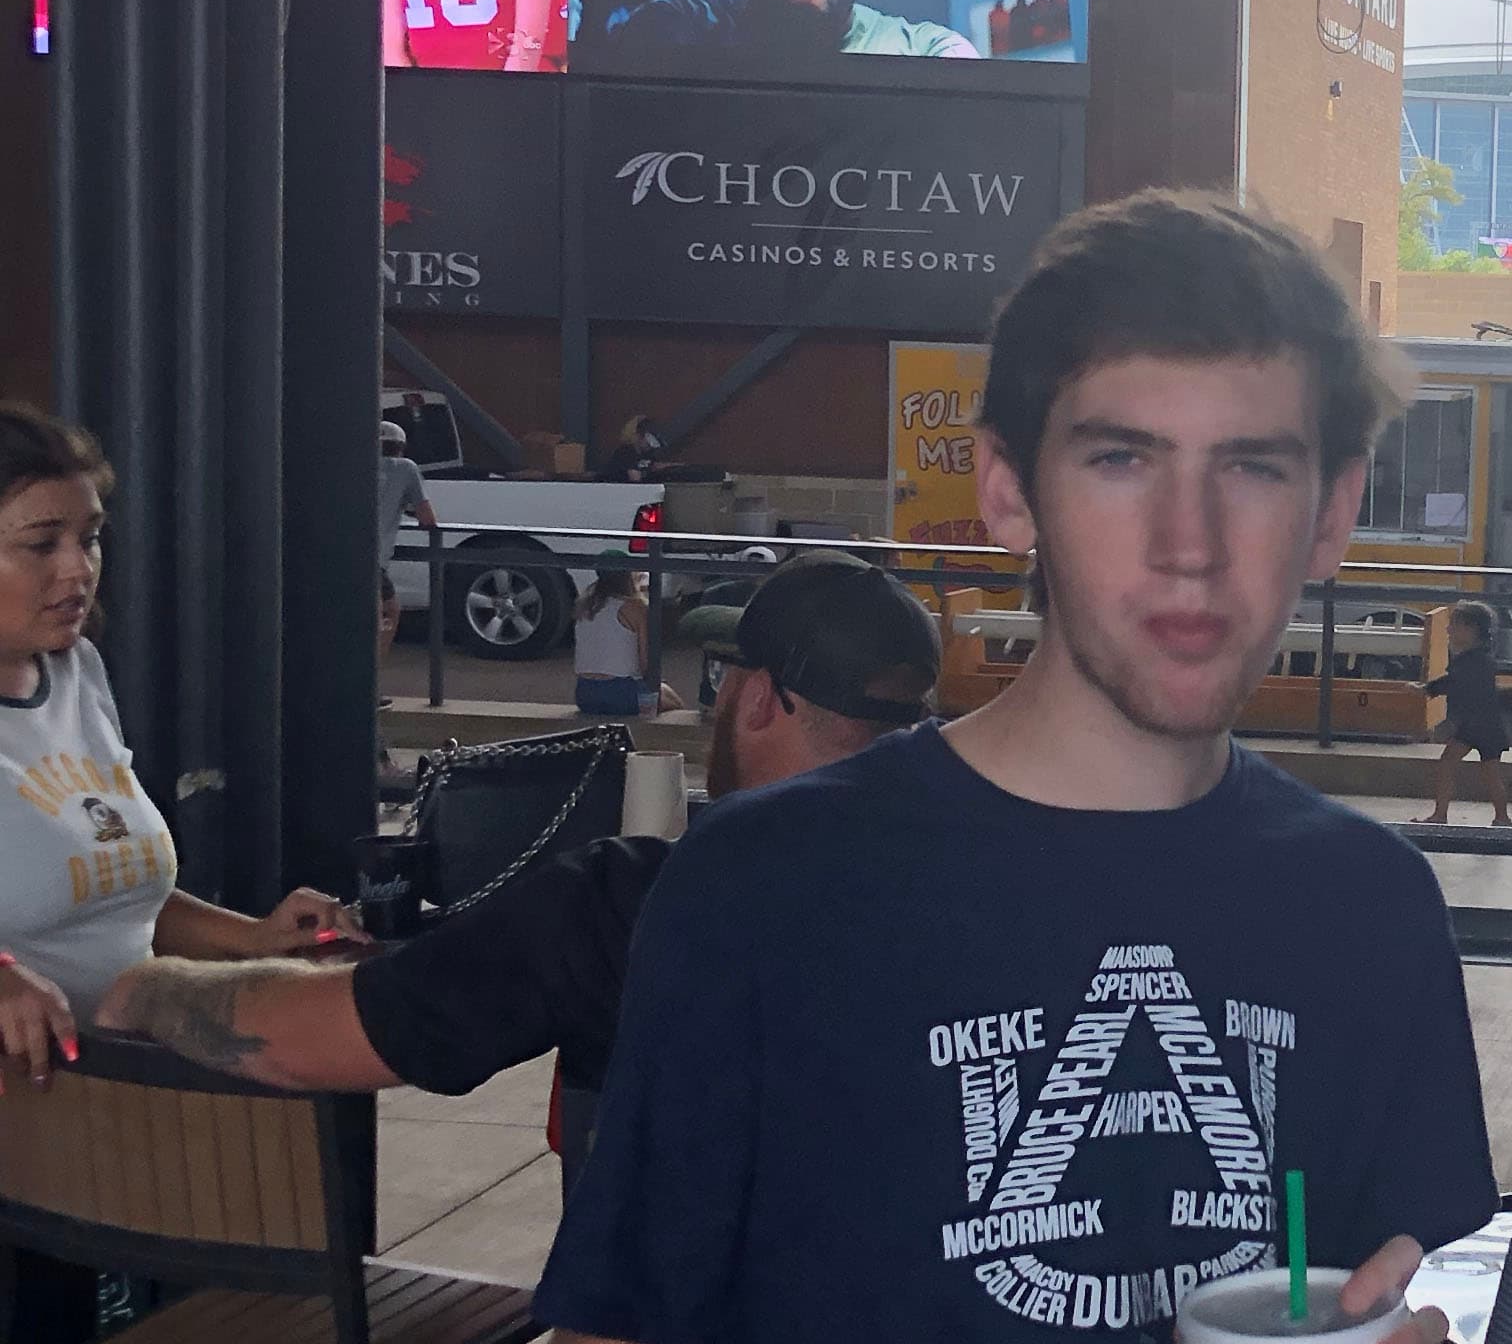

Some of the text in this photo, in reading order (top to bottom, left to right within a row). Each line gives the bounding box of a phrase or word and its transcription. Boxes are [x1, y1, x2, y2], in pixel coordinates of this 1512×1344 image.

[656, 151, 1025, 217] CHOCTAW
[687, 242, 996, 273] CASINOS & RESORTS
[917, 436, 974, 474] ME
[1085, 971, 1193, 1002] SPENCER
[929, 1008, 1046, 1067] OKEKE
[1225, 999, 1296, 1050] BROWN
[960, 1064, 997, 1161] DOUGHTY
[990, 1004, 1138, 1211] BRUCE PEARL
[1090, 1090, 1192, 1138] HARPER
[1143, 1004, 1272, 1193] MCLEMORE
[942, 1198, 1104, 1260] MCCORMICK
[975, 1258, 1066, 1327] COLLIER
